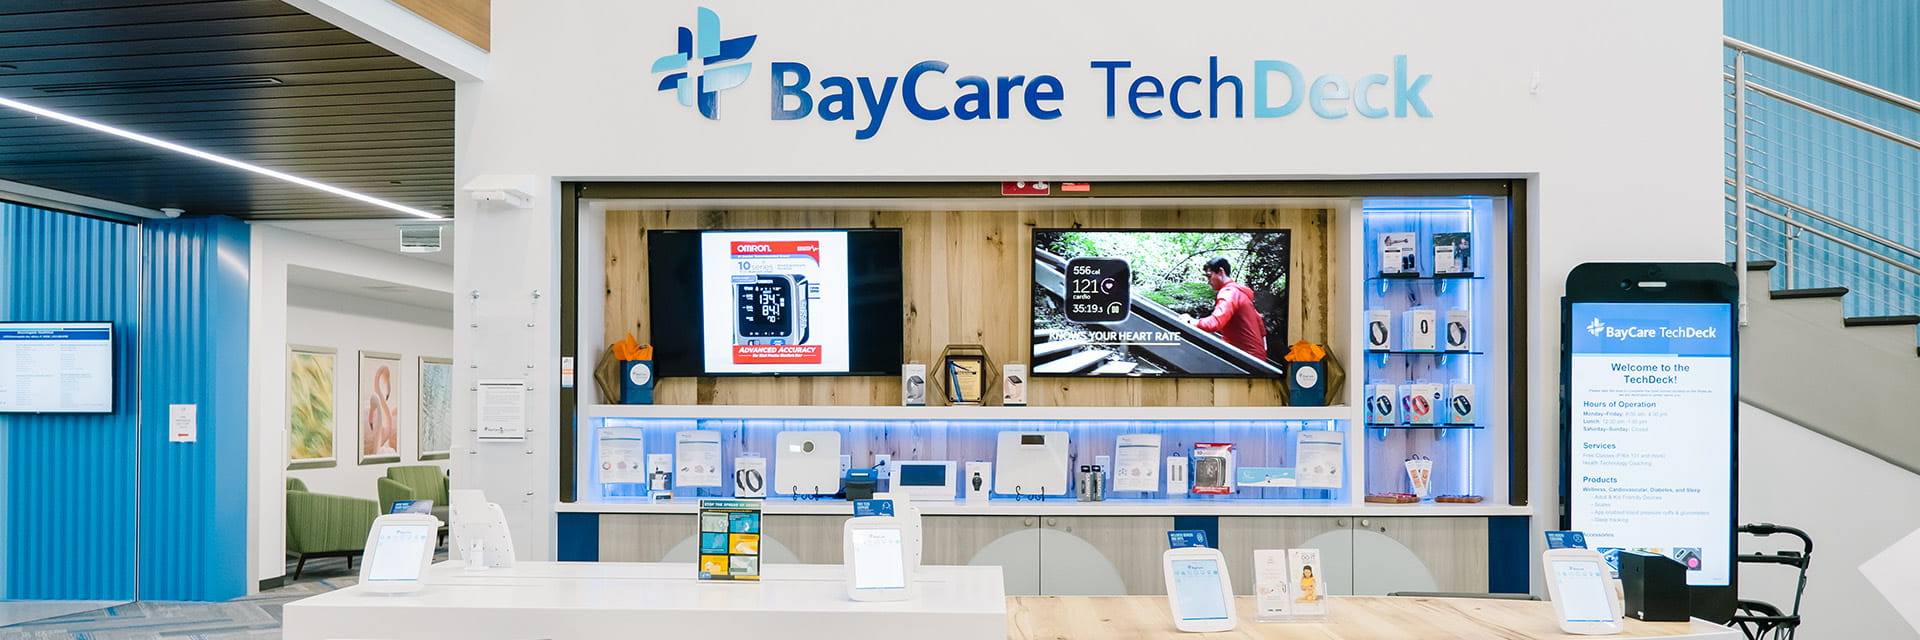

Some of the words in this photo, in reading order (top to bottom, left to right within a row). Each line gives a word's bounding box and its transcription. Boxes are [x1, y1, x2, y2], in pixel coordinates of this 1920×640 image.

[771, 60, 1064, 140] BayCare
[1091, 54, 1433, 120] TechDeck
[737, 244, 772, 252] OMRON
[738, 261, 751, 270] 10
[1072, 278, 1099, 294] 121
[1049, 331, 1087, 341] KNOWS
[1090, 331, 1117, 341] YOUR
[1118, 331, 1152, 341] HEART
[1155, 331, 1181, 341] RATE
[1606, 326, 1657, 341] BayCare
[1659, 326, 1717, 339] TechDeck
[1611, 363, 1658, 372] Welcome
[1661, 364, 1671, 372] to
[1674, 363, 1690, 372] the
[1624, 375, 1677, 384] TechDeck!
[1618, 401, 1656, 409] Operation
[1583, 476, 1618, 484] Products
